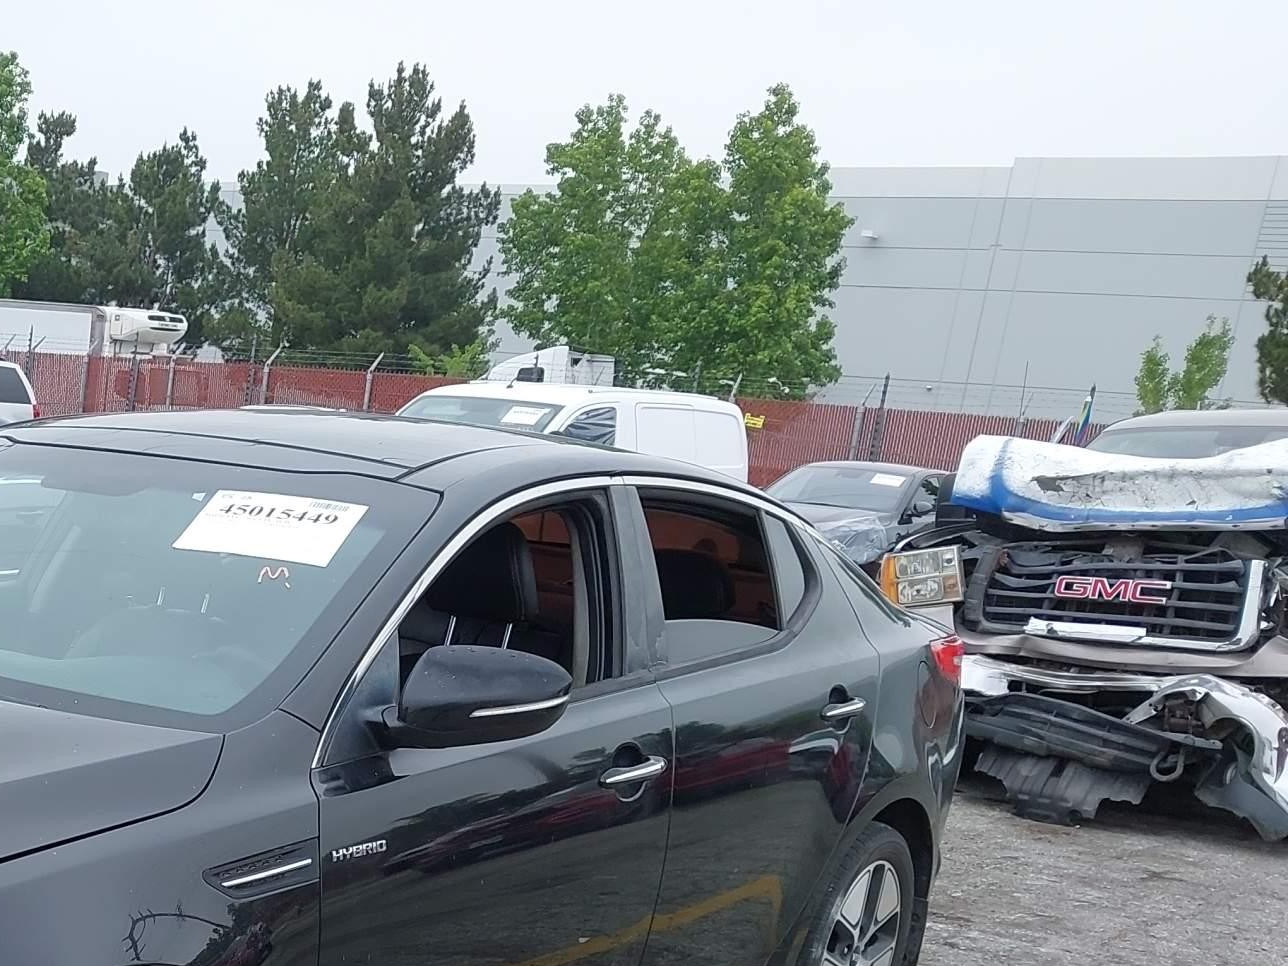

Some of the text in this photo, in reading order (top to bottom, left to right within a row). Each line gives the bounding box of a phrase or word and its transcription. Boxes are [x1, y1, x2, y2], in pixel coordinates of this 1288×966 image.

[219, 503, 339, 525] 45015449
[1054, 575, 1172, 605] GMC
[332, 839, 387, 862] HYBRID
